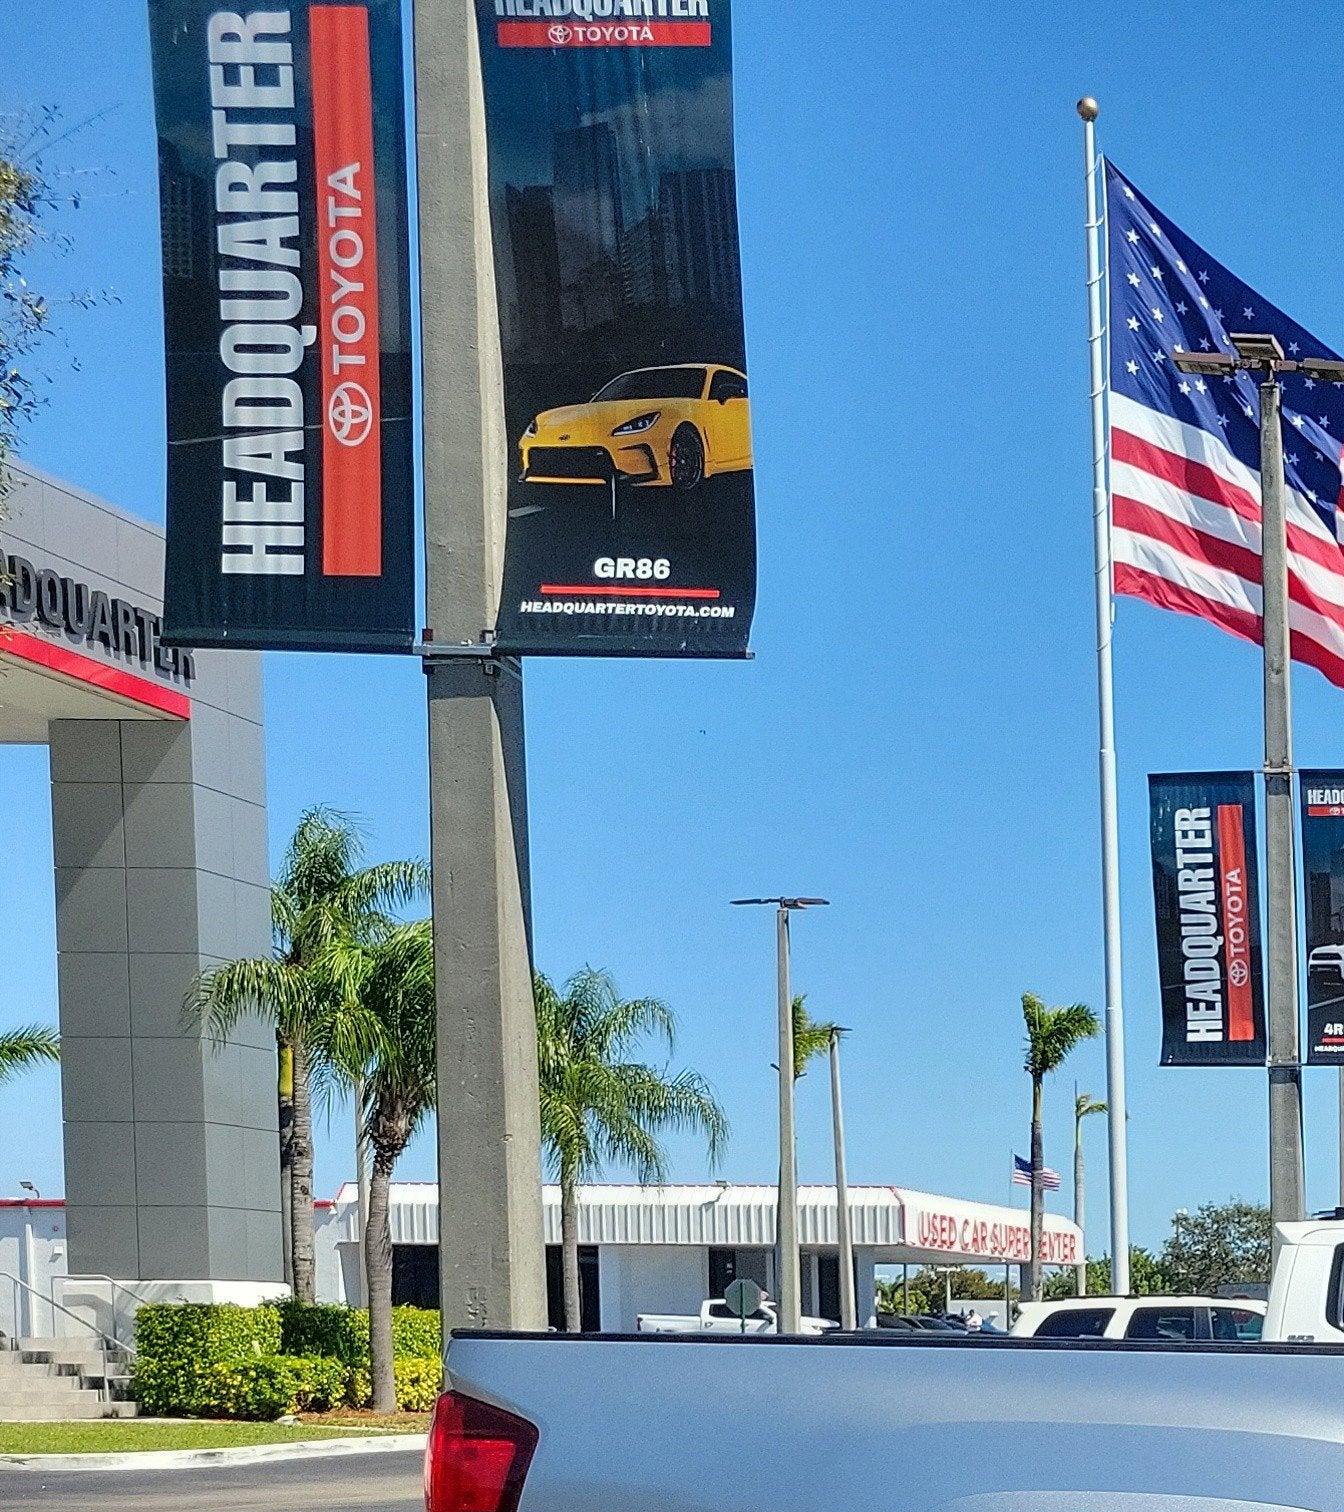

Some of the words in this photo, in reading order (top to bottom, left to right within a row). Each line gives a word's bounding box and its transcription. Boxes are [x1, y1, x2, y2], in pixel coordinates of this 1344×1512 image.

[573, 26, 655, 42] TOYOTA
[207, 9, 318, 575] HEADQUARTER
[327, 161, 367, 376] TOYOTA
[593, 556, 671, 580] GR86
[520, 601, 736, 619] HEADQUARTERTOYOTA.COM
[1173, 806, 1224, 1043] HEADQUARTER
[1225, 866, 1245, 957] TOYOTA
[918, 1210, 958, 1249] USED
[959, 1217, 990, 1254] CAR
[990, 1222, 1031, 1259] SUPER
[1037, 1230, 1077, 1263] ENTER
